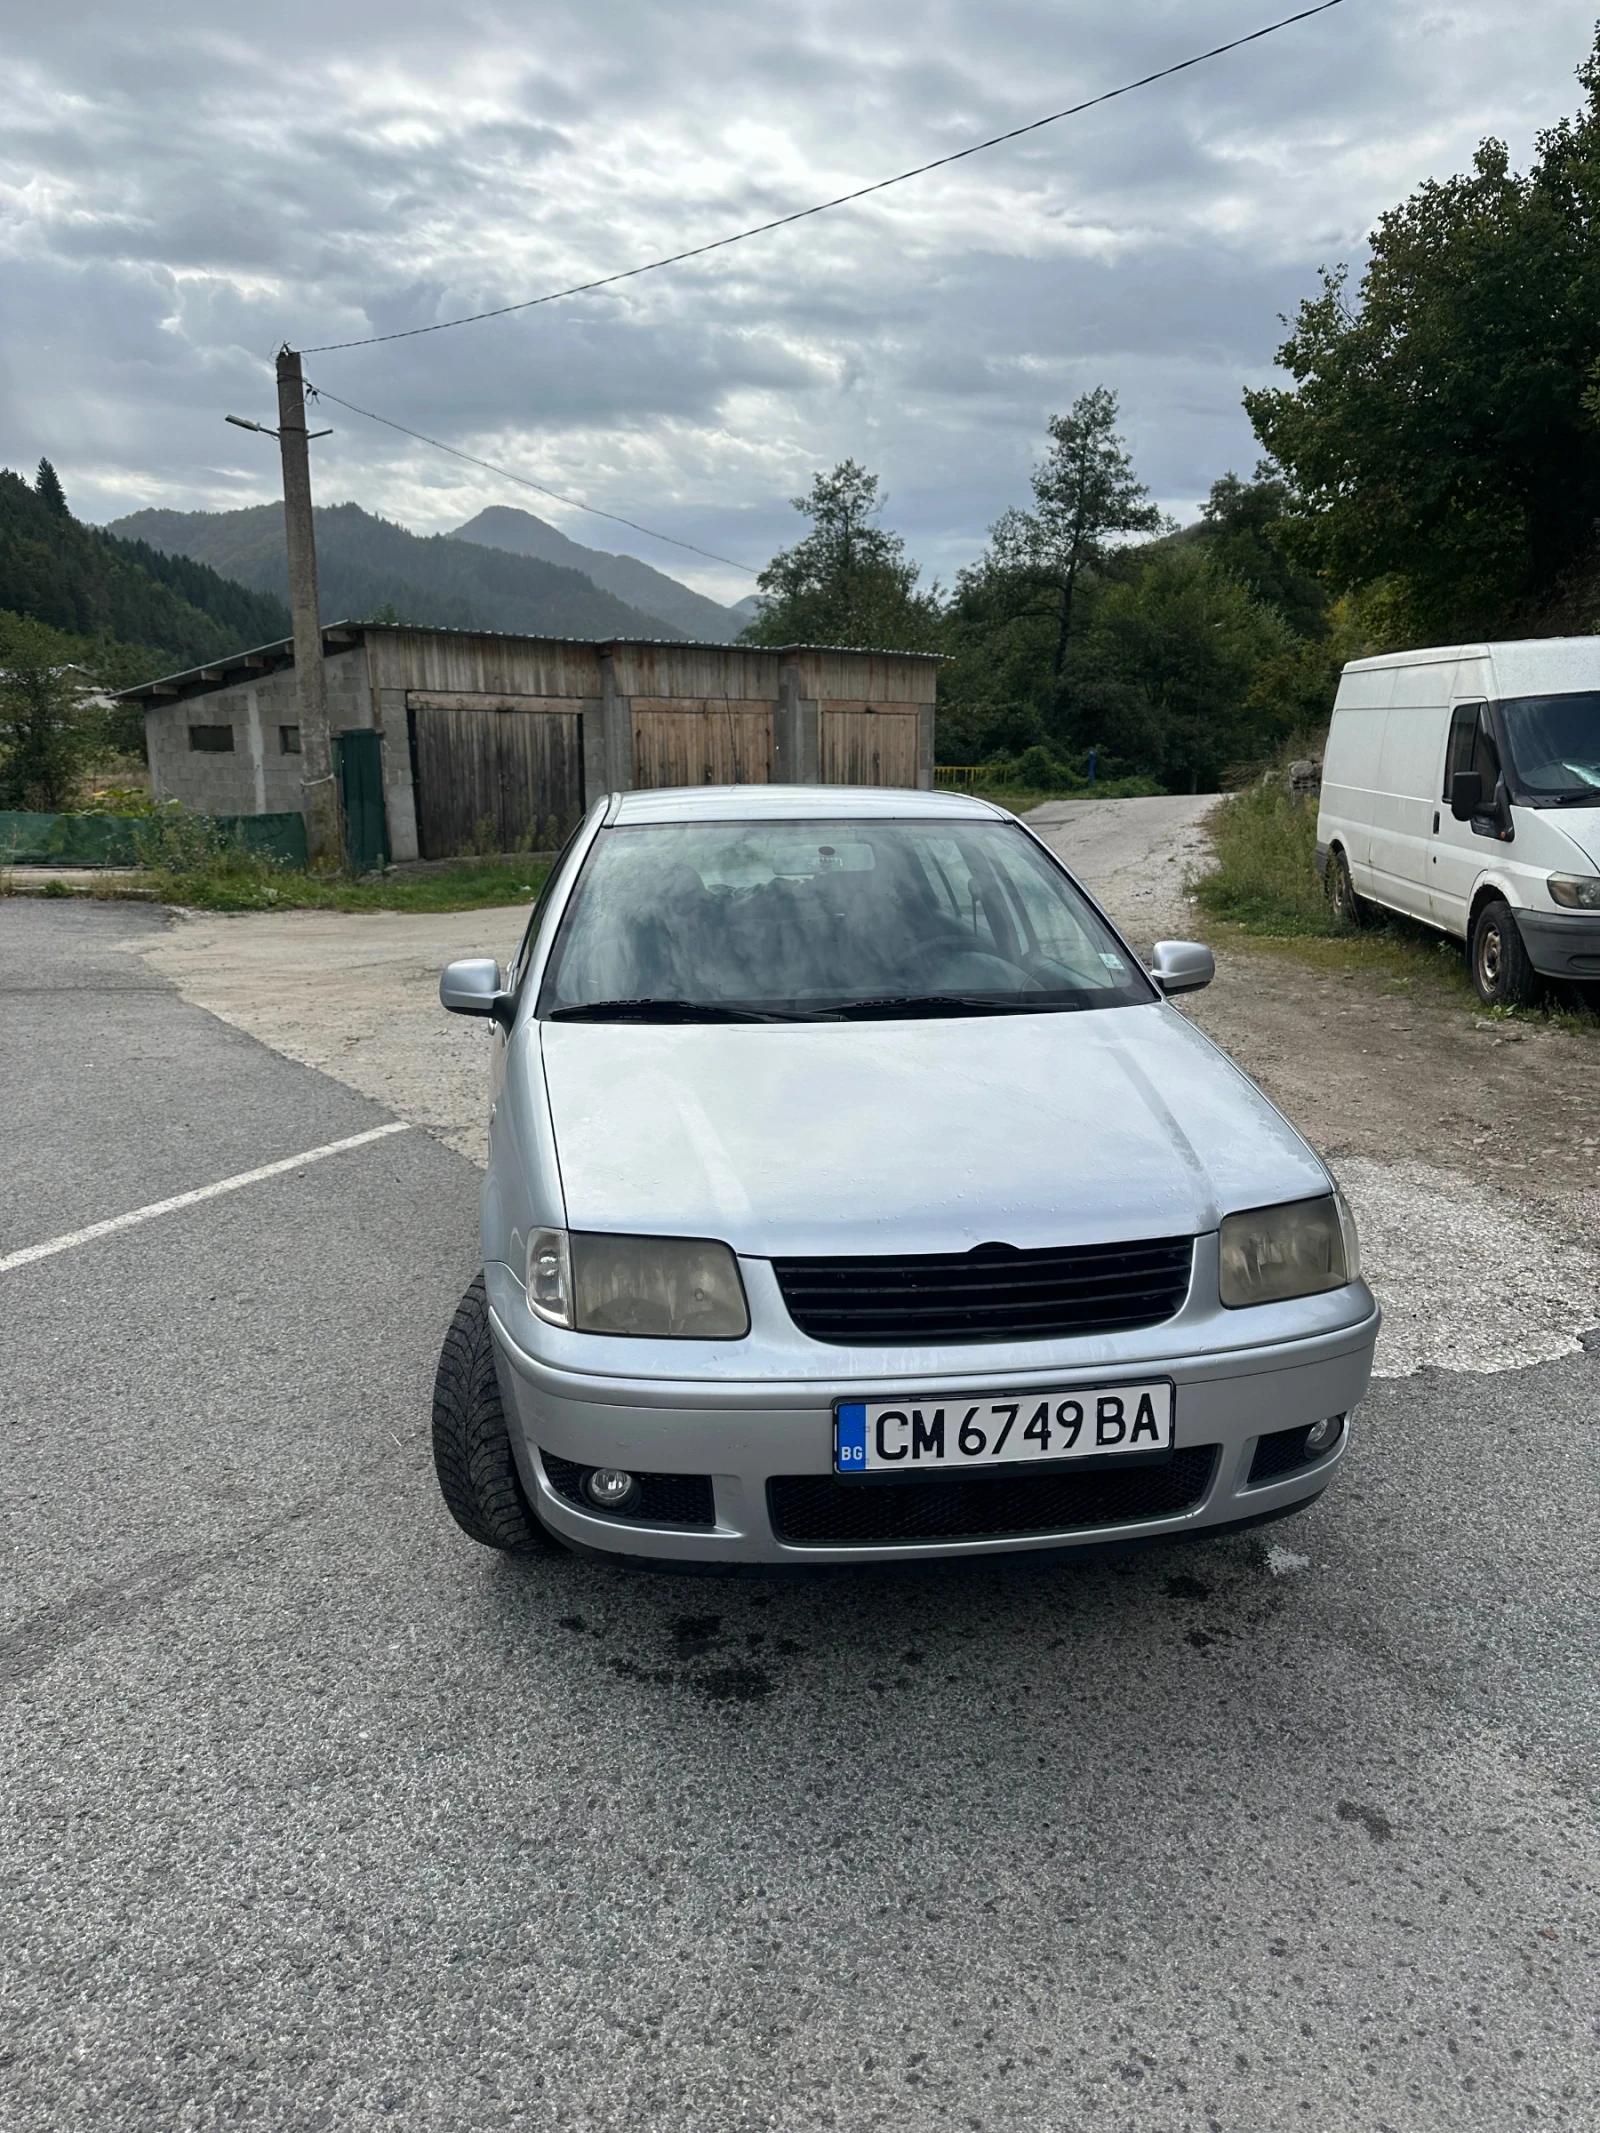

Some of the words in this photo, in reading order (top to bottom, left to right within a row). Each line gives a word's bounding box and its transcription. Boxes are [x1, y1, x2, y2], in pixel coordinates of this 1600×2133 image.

[876, 1408, 945, 1461] CM
[957, 1399, 1084, 1456] 6749
[1096, 1392, 1160, 1447] BA
[841, 1446, 863, 1461] BG
